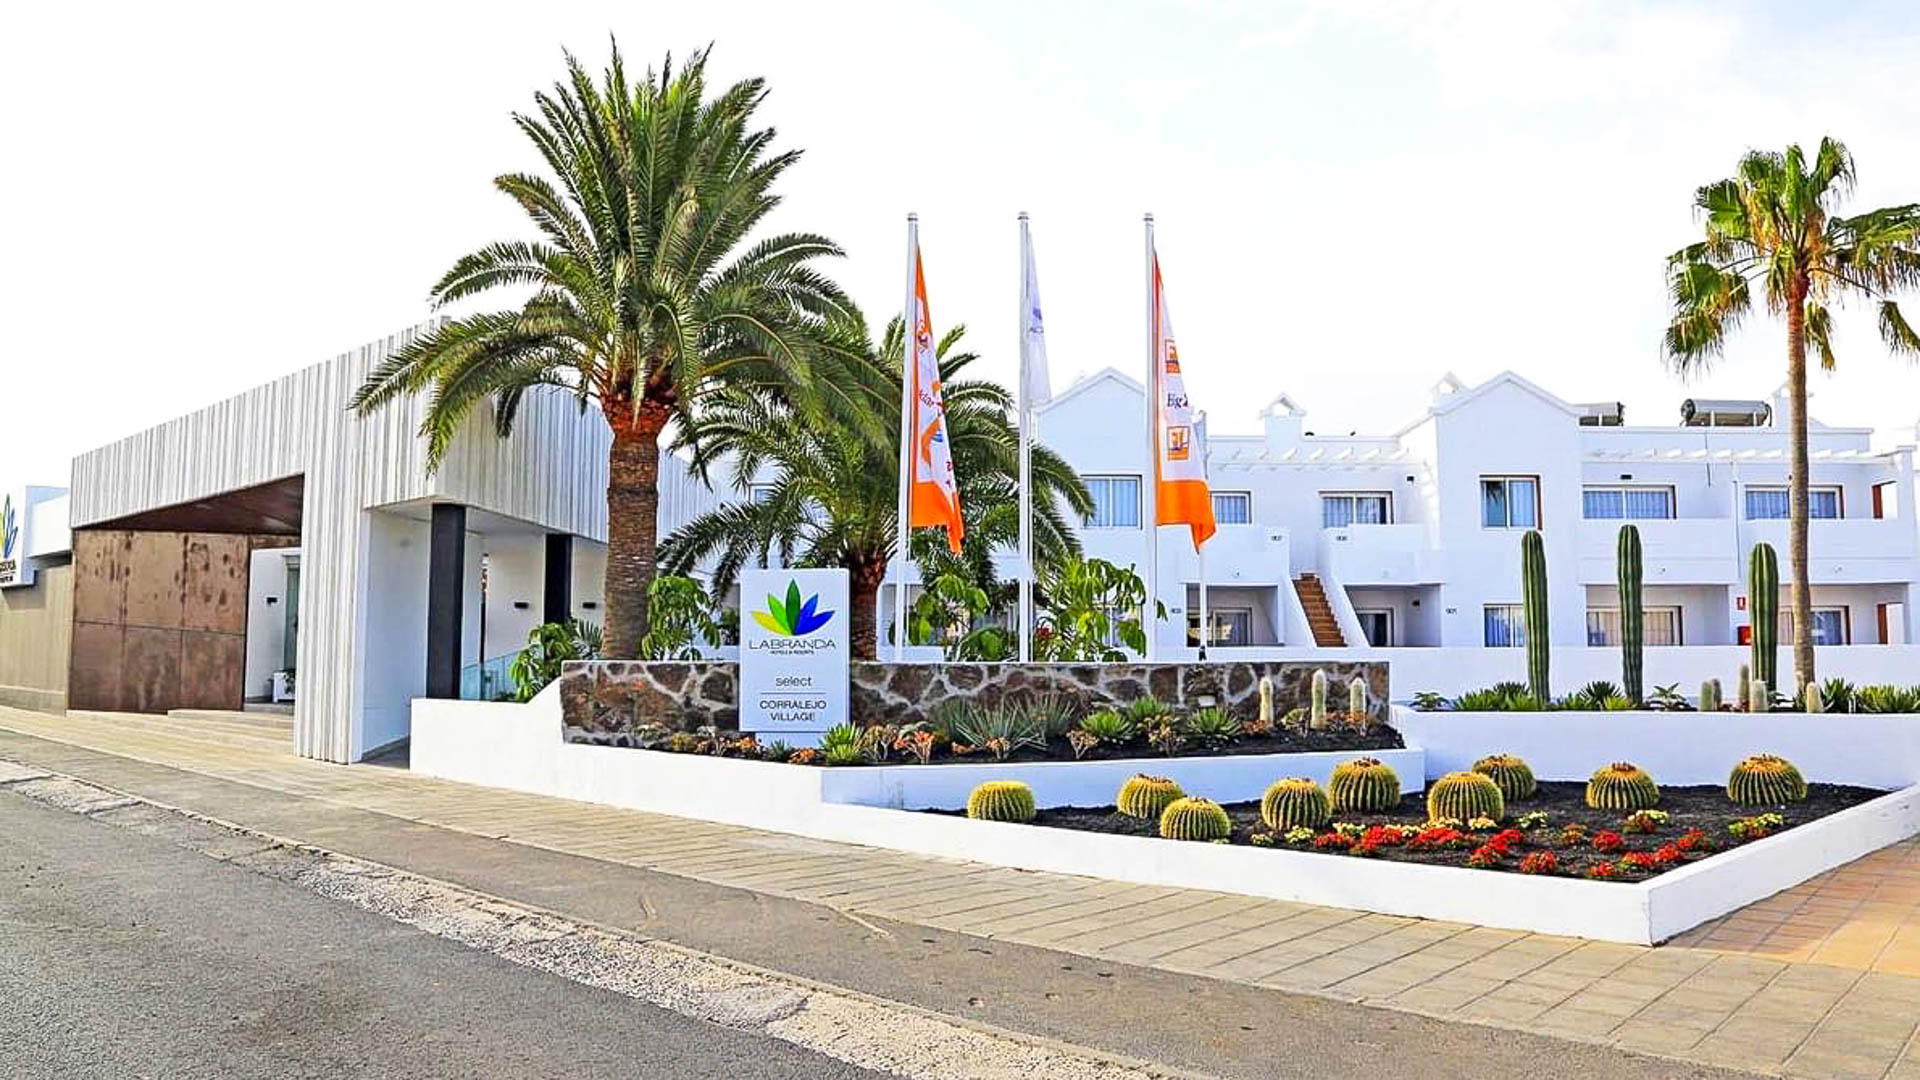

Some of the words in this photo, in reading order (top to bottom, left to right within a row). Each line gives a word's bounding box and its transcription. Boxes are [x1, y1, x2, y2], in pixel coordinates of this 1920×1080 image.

[749, 638, 836, 650] LABRANDA
[775, 676, 812, 687] select
[759, 699, 827, 710] CORRALEJO
[770, 711, 816, 721] VILLAGE
